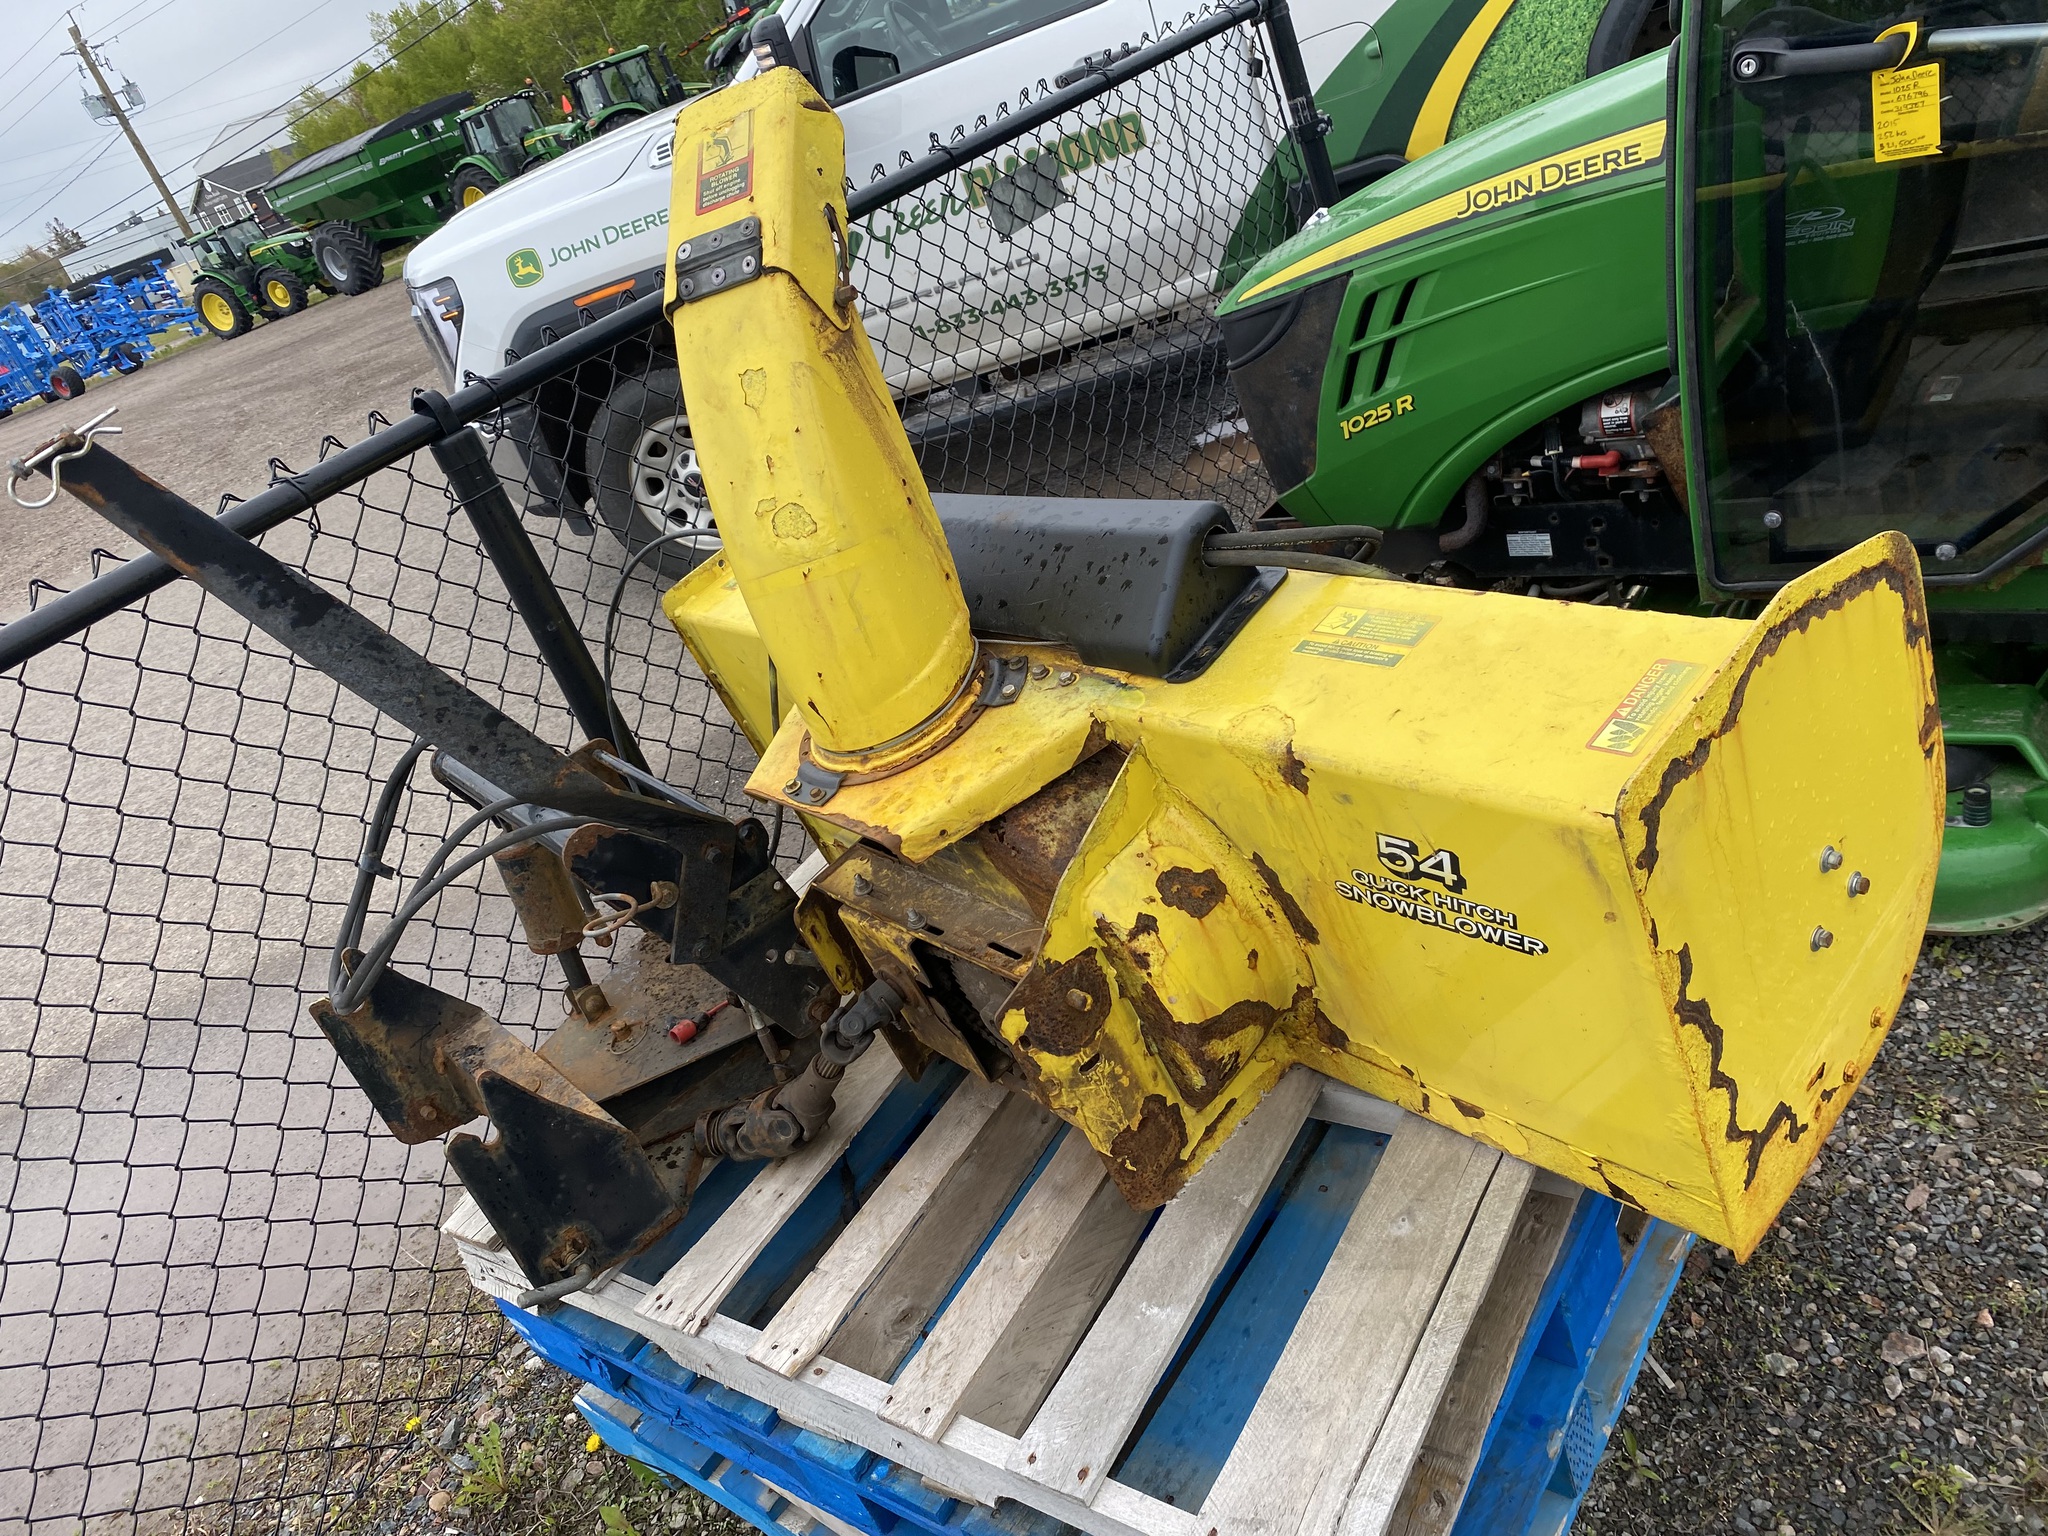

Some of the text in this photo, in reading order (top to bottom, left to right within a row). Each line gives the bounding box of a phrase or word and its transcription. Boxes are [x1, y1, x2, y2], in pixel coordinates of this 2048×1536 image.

[710, 166, 740, 183] ROTATING
[711, 173, 738, 188] BLOWER
[1457, 143, 1642, 216] JOHN DEERE
[548, 208, 669, 267] JOHN DEERE
[913, 264, 1109, 339] 1-833-443-3373
[1339, 394, 1415, 440] 1025 R
[1340, 640, 1380, 650] CAUTION
[1625, 662, 1668, 706] DANGER
[1376, 832, 1466, 893] 54
[1334, 880, 1549, 956] SNOWBLOWER
[1351, 869, 1517, 930] QUICK HITCH
